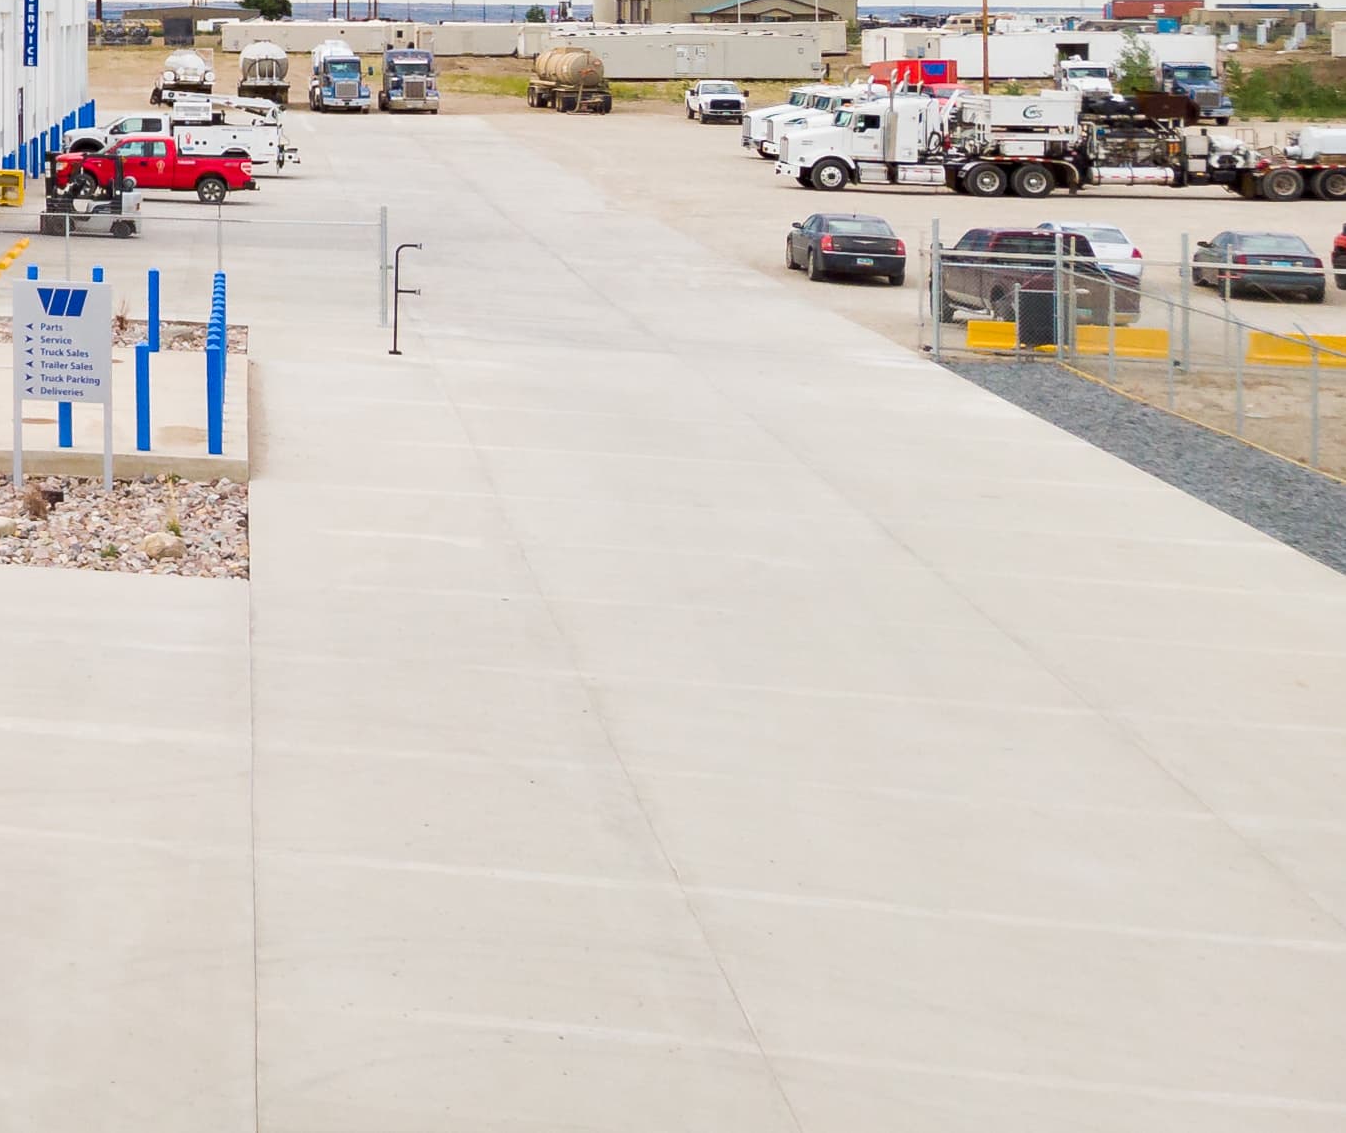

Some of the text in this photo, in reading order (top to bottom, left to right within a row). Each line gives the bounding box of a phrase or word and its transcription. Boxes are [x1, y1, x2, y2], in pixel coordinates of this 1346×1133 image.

[40, 323, 63, 332] Parts
[40, 335, 72, 345] Service
[40, 348, 89, 358] Truck Sales
[40, 361, 94, 371] Trailer Sales
[40, 374, 101, 386] Truck Parking
[40, 387, 84, 397] Deliveries
